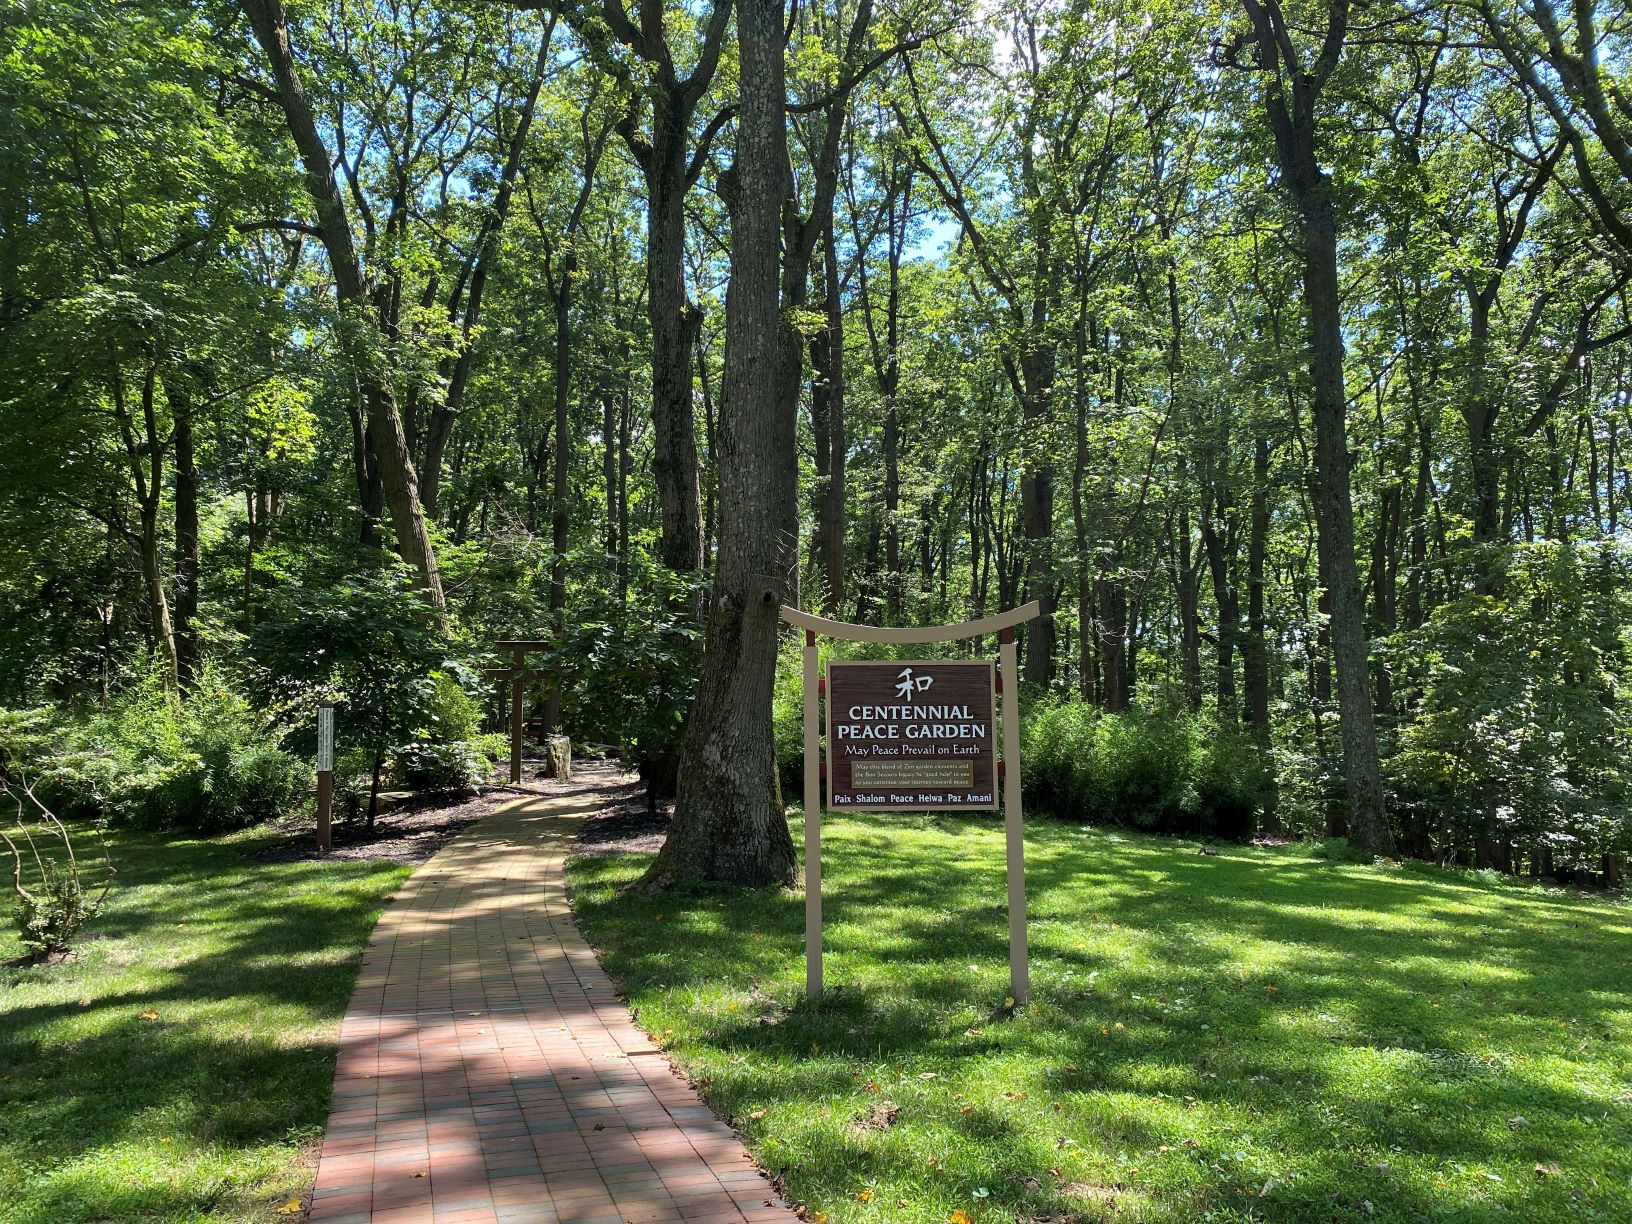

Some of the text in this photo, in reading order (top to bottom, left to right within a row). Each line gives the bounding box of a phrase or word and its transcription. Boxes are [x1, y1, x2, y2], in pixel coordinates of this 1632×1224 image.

[895, 667, 934, 702] 和
[848, 705, 974, 721] CENTENNIAL
[837, 724, 985, 739] PEACE GARDEN
[844, 744, 980, 758] May Peace Prevail on Earth
[834, 793, 992, 803] Paix Shalom Peace Heiwa Paz Amani
